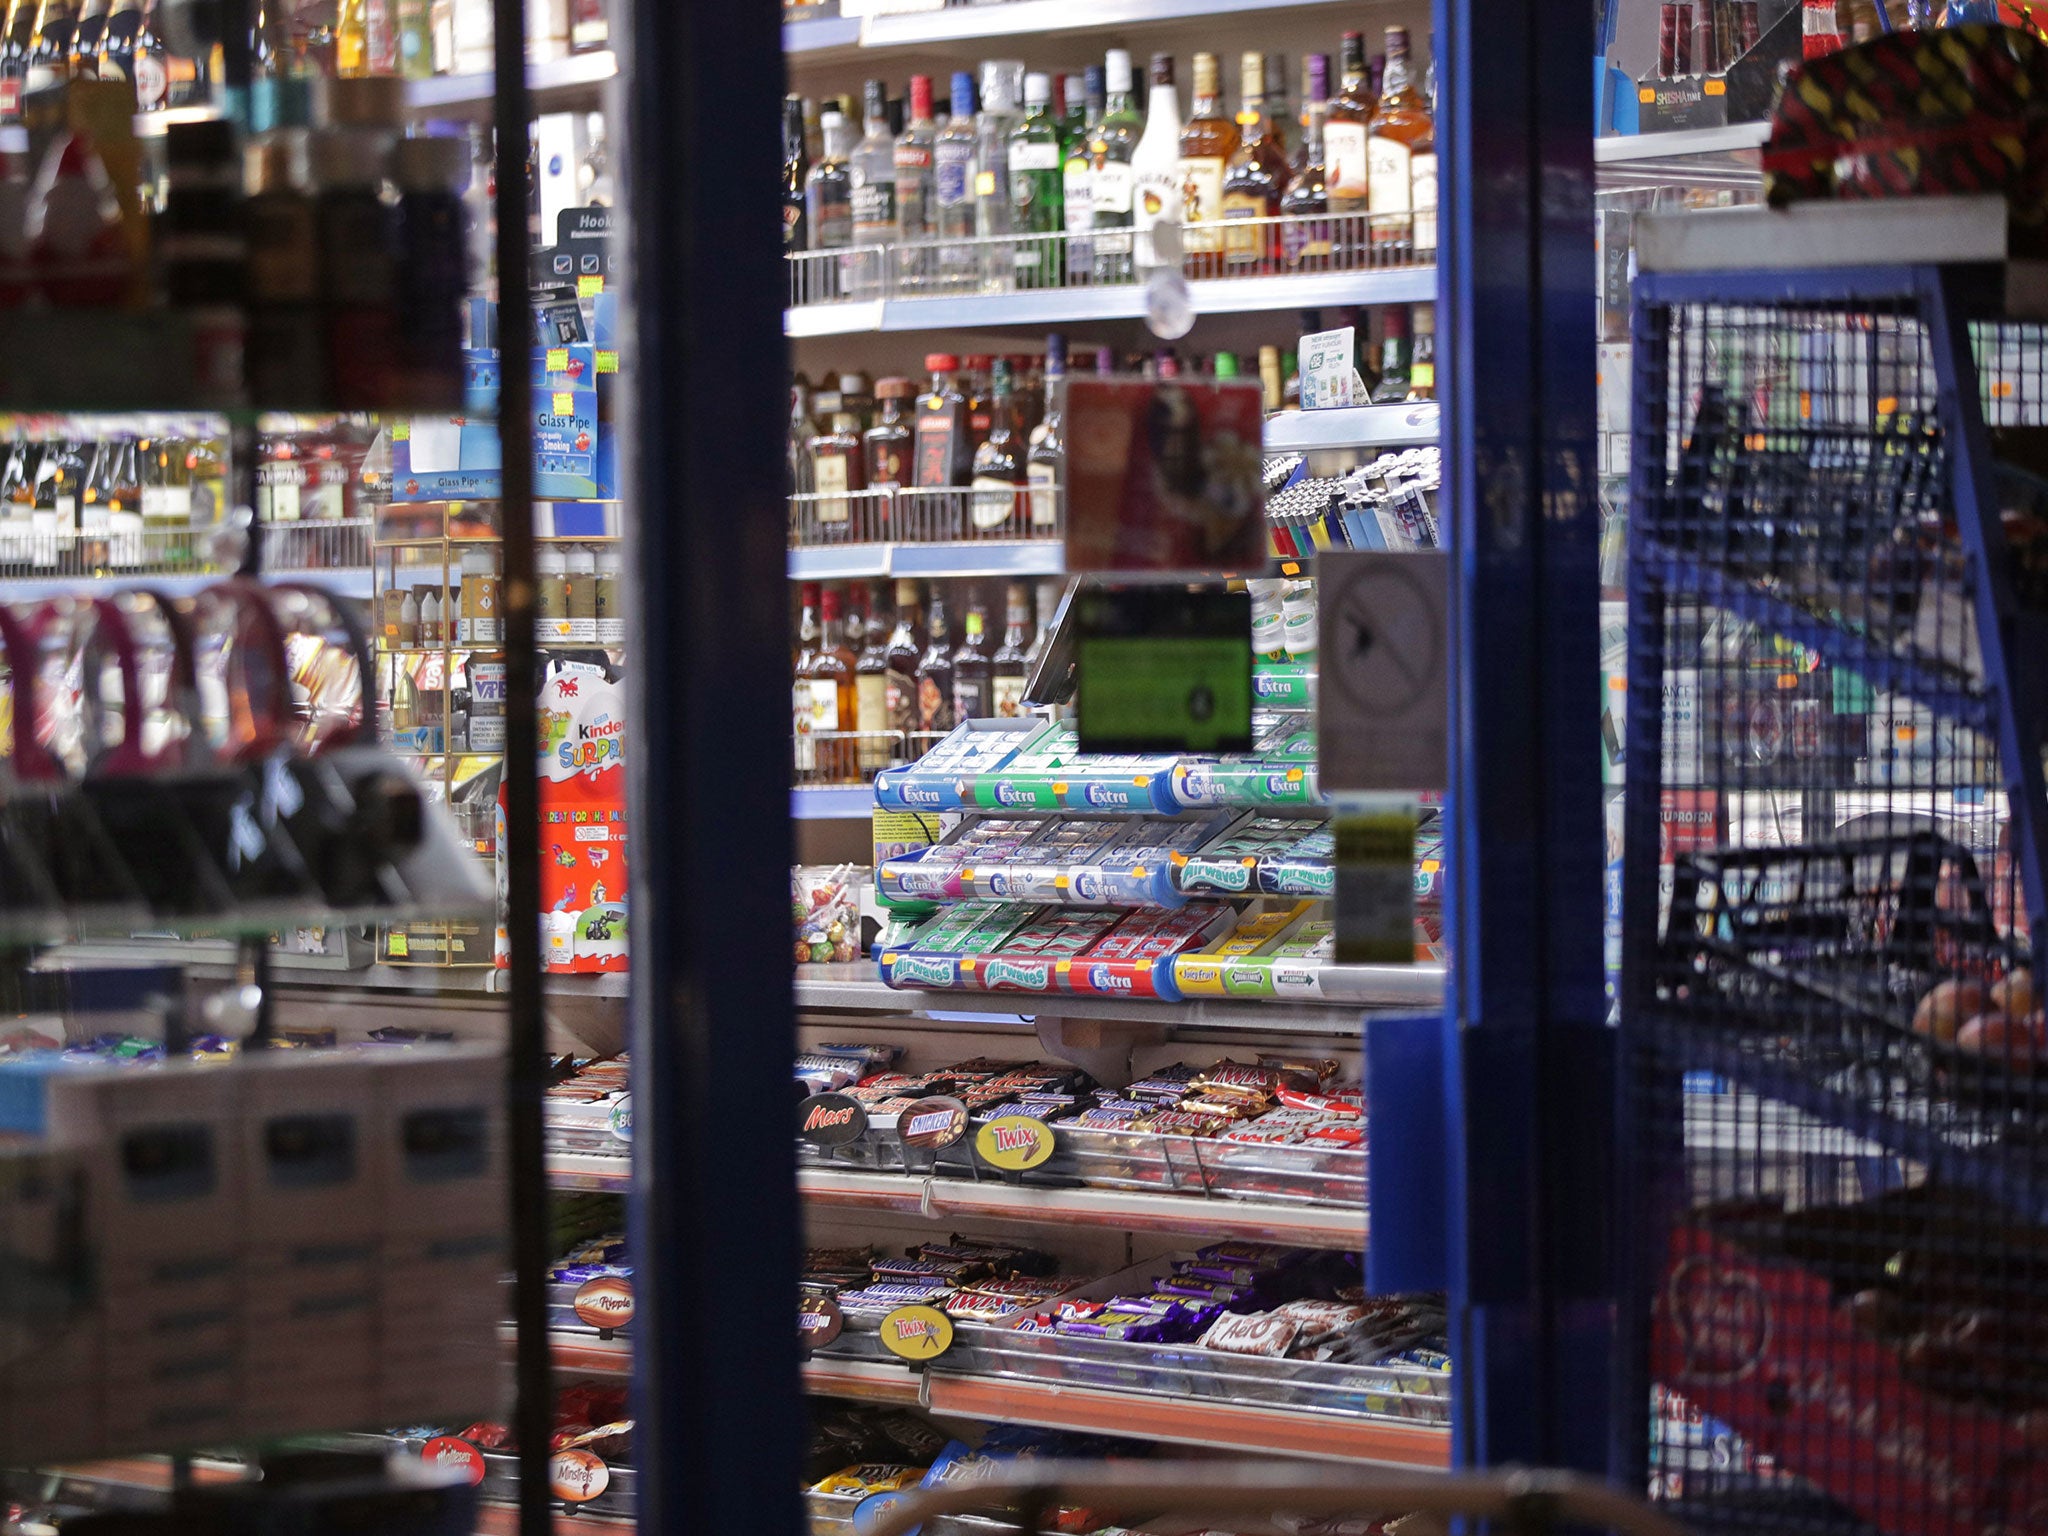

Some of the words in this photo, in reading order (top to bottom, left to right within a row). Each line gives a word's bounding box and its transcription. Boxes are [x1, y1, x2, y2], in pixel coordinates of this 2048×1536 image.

[538, 413, 566, 429] Glass
[569, 413, 590, 432] Pipe
[543, 440, 570, 453] Smoking
[438, 477, 460, 487] Glass
[461, 476, 480, 489] Pipe
[1424, 512, 1438, 545] London
[1258, 677, 1292, 693] Extra
[579, 720, 626, 739] Kinder
[904, 782, 940, 803] Extra
[999, 782, 1036, 803] Extra
[1187, 776, 1226, 796] Extra
[1270, 775, 1300, 792] Extra
[1089, 784, 1129, 804] Extra
[546, 811, 568, 824] TREAT
[571, 811, 587, 823] FOR
[590, 810, 605, 823] THE
[1182, 862, 1247, 885] Airwaves
[1279, 867, 1335, 885] Airwaves
[901, 877, 928, 893] Extra
[993, 878, 1026, 894] Extra
[1082, 876, 1119, 897] Extra
[893, 957, 951, 982] Airwaves
[986, 958, 1045, 985] Airwaves
[1094, 969, 1132, 989] Extra
[1183, 970, 1198, 981] Juicy
[1198, 969, 1215, 979] Fruit
[1212, 1064, 1268, 1086] TWIX
[803, 1104, 854, 1132] Mars
[910, 1111, 953, 1135] SNICKERS
[993, 1124, 1034, 1152] Twix
[600, 1295, 631, 1311] Ripple
[946, 1292, 1004, 1310] TWIX
[896, 1316, 926, 1341] Twix
[1220, 1318, 1272, 1343] Aero
[436, 1447, 472, 1468] Maltesers
[557, 1464, 594, 1483] Minstrels
